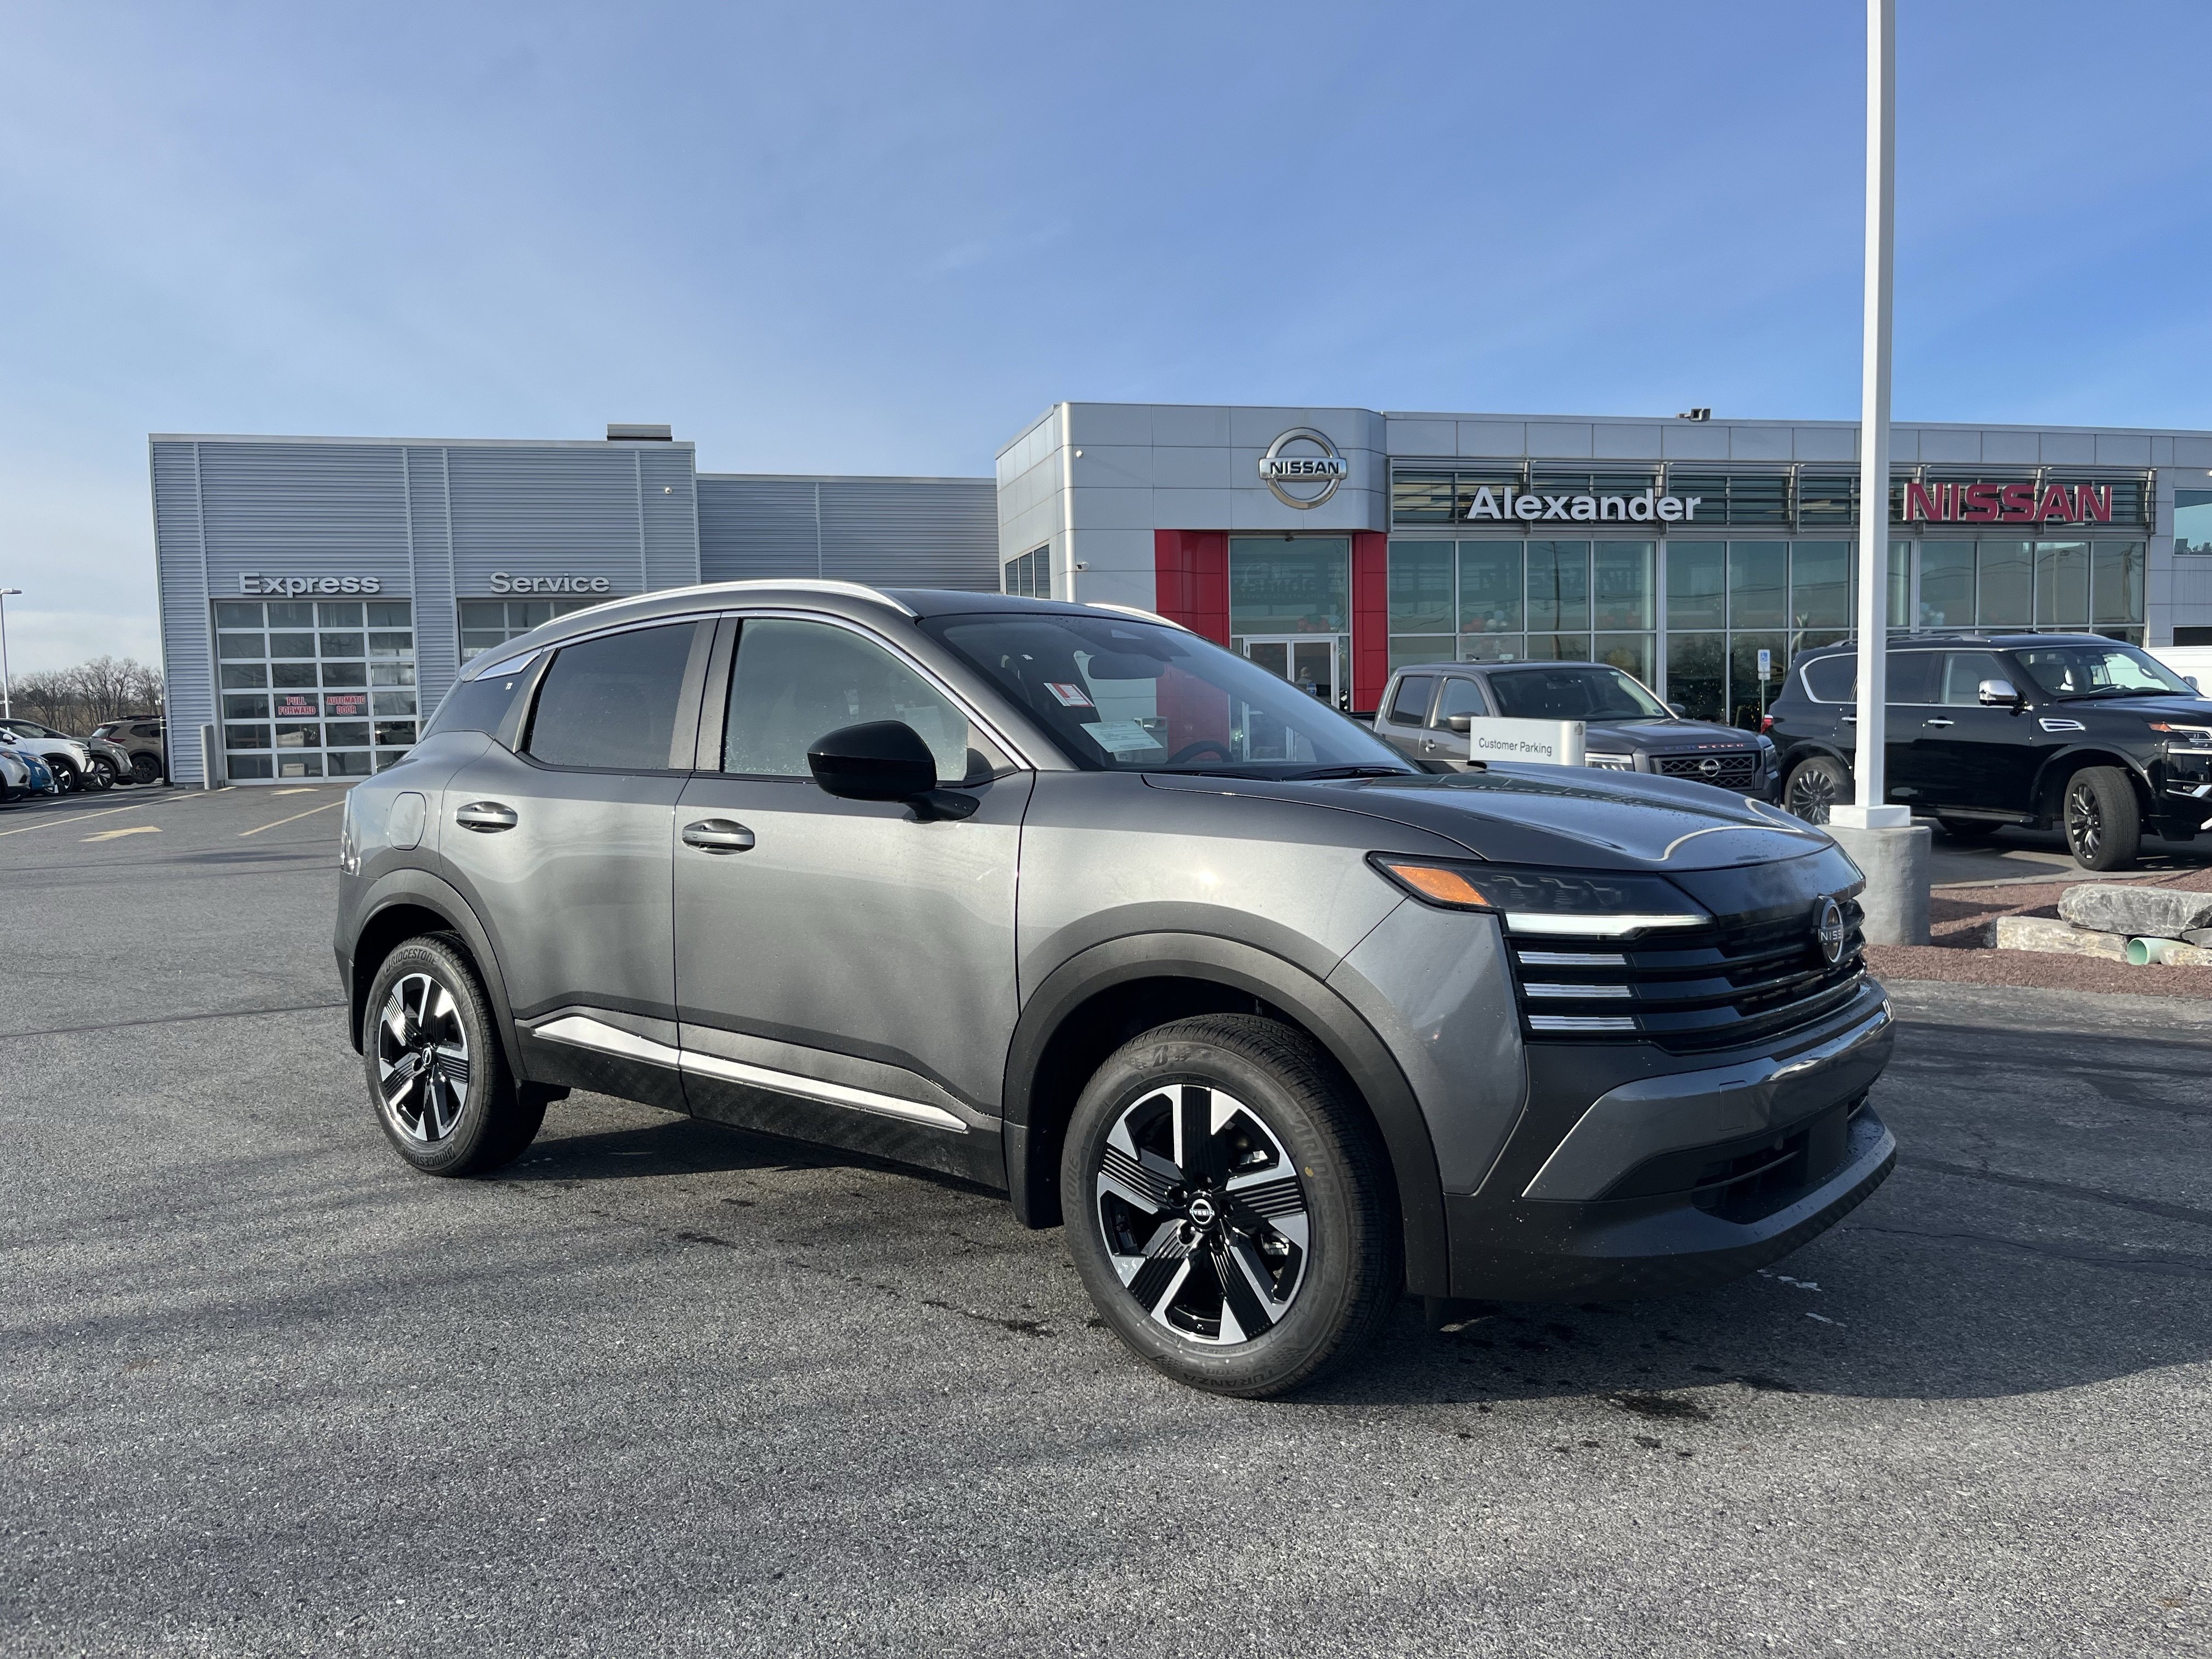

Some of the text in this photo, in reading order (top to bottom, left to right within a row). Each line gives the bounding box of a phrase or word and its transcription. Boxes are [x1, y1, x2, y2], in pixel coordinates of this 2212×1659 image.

[1269, 461, 1339, 475] NISSAN
[1466, 487, 1701, 522] Alexander
[1903, 483, 2112, 522] NISSAN
[238, 572, 380, 598] Express
[490, 572, 610, 593] Service
[278, 706, 316, 715] FORWARD
[286, 697, 307, 706] PULL
[326, 696, 366, 705] AUTOMATIC
[336, 706, 357, 714] DOOR
[1479, 737, 1552, 757] Customer Parking
[386, 949, 437, 973] BRIDGESTONE
[401, 1146, 456, 1166] BRIDGESTONE
[1183, 1369, 1277, 1387] TURANZA
